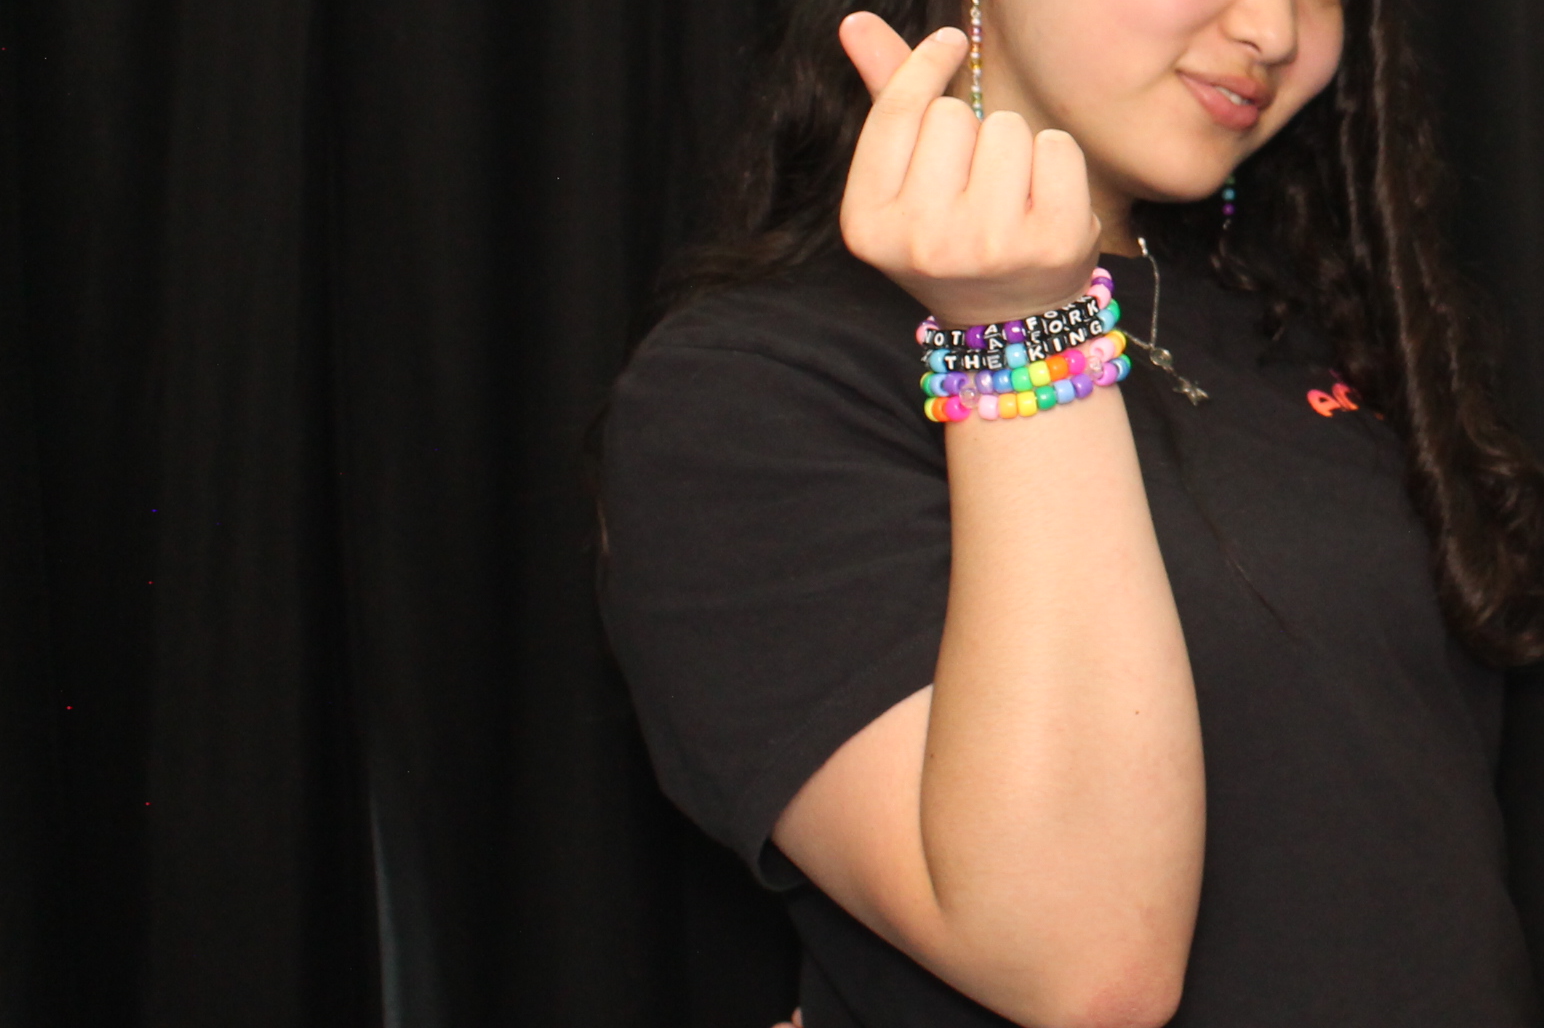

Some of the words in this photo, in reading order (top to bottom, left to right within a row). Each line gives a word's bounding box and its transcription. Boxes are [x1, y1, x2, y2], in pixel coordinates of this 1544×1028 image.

[1025, 299, 1100, 334] FORK
[944, 355, 1003, 370] THE
[1028, 320, 1103, 362] KING
